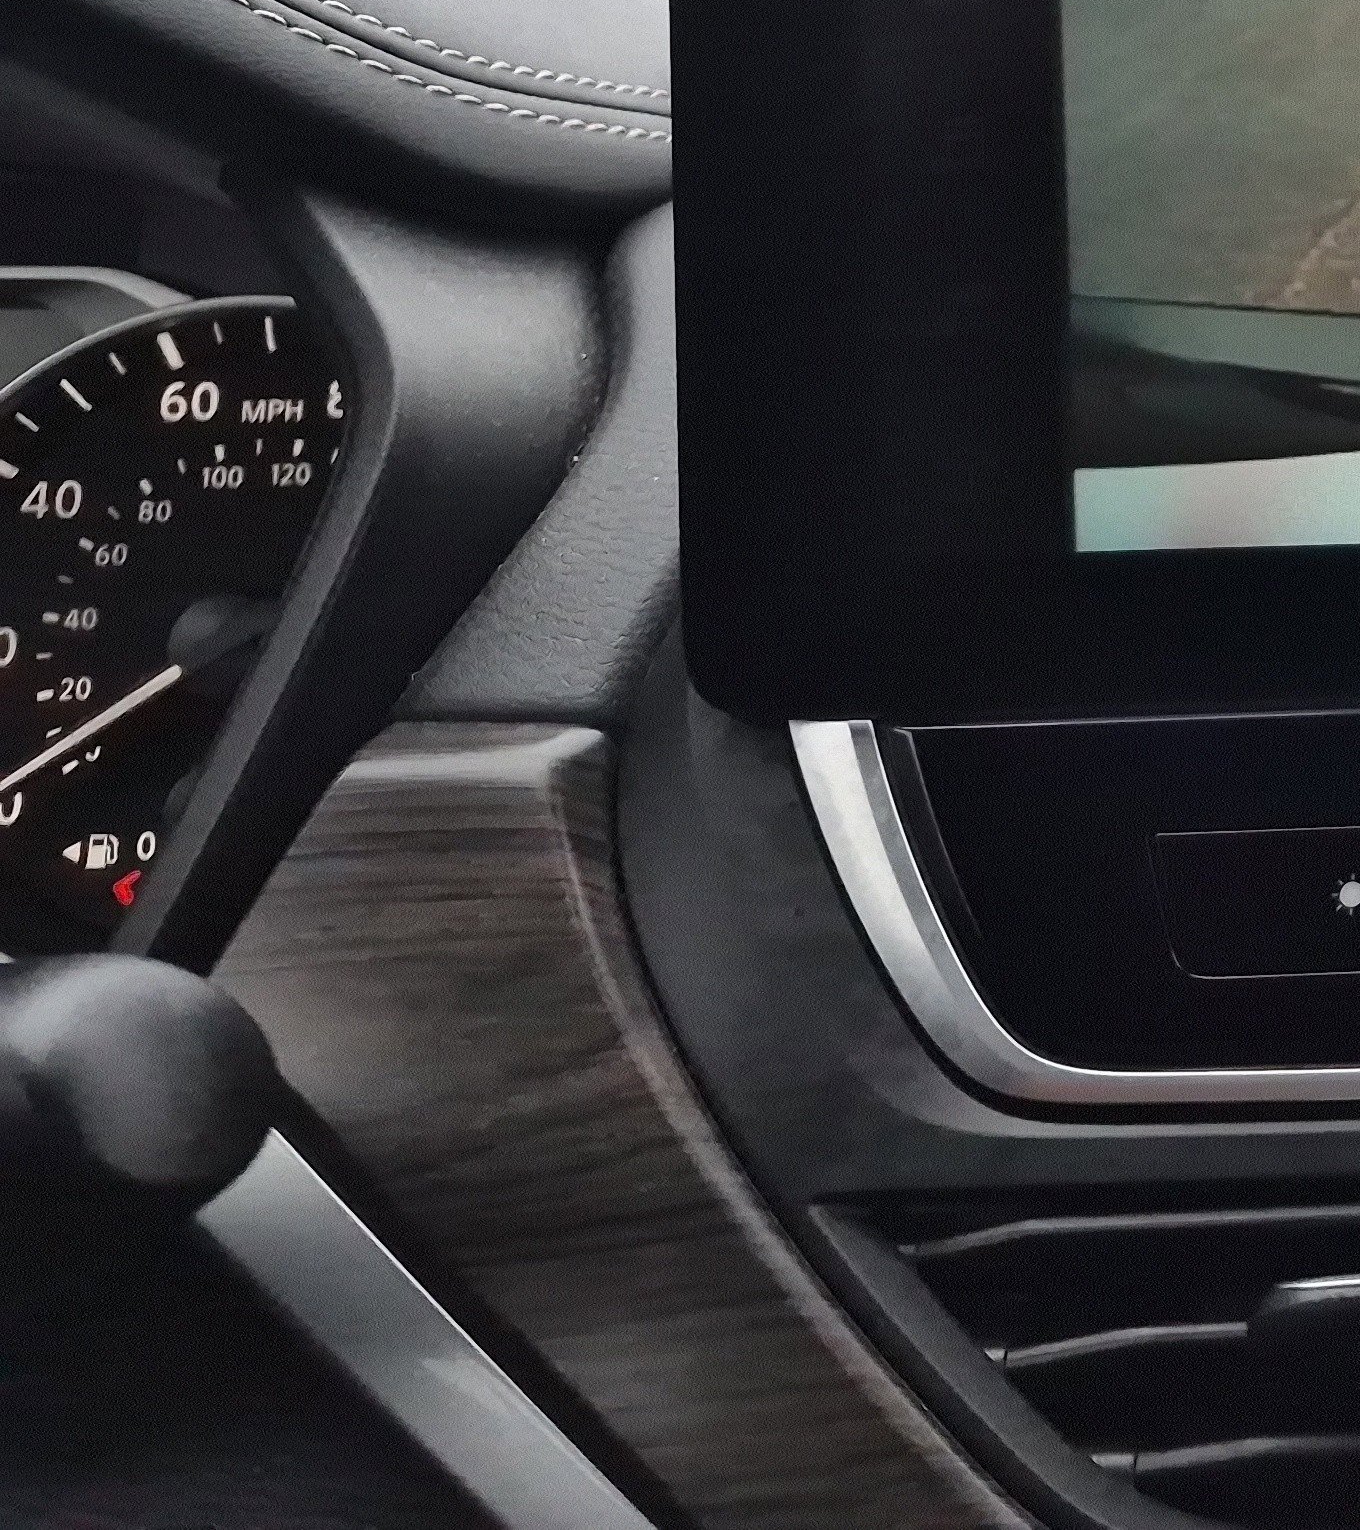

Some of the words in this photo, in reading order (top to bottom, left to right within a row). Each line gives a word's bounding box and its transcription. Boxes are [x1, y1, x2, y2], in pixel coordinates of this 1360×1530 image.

[160, 381, 219, 422] 60
[241, 398, 304, 423] MPH
[202, 465, 244, 489] 100
[271, 462, 312, 487] 120
[20, 480, 82, 520] 40
[138, 499, 172, 523] 80
[95, 543, 128, 566] 60
[63, 606, 98, 631] 40
[58, 676, 92, 701] 20
[136, 830, 156, 861] 0
